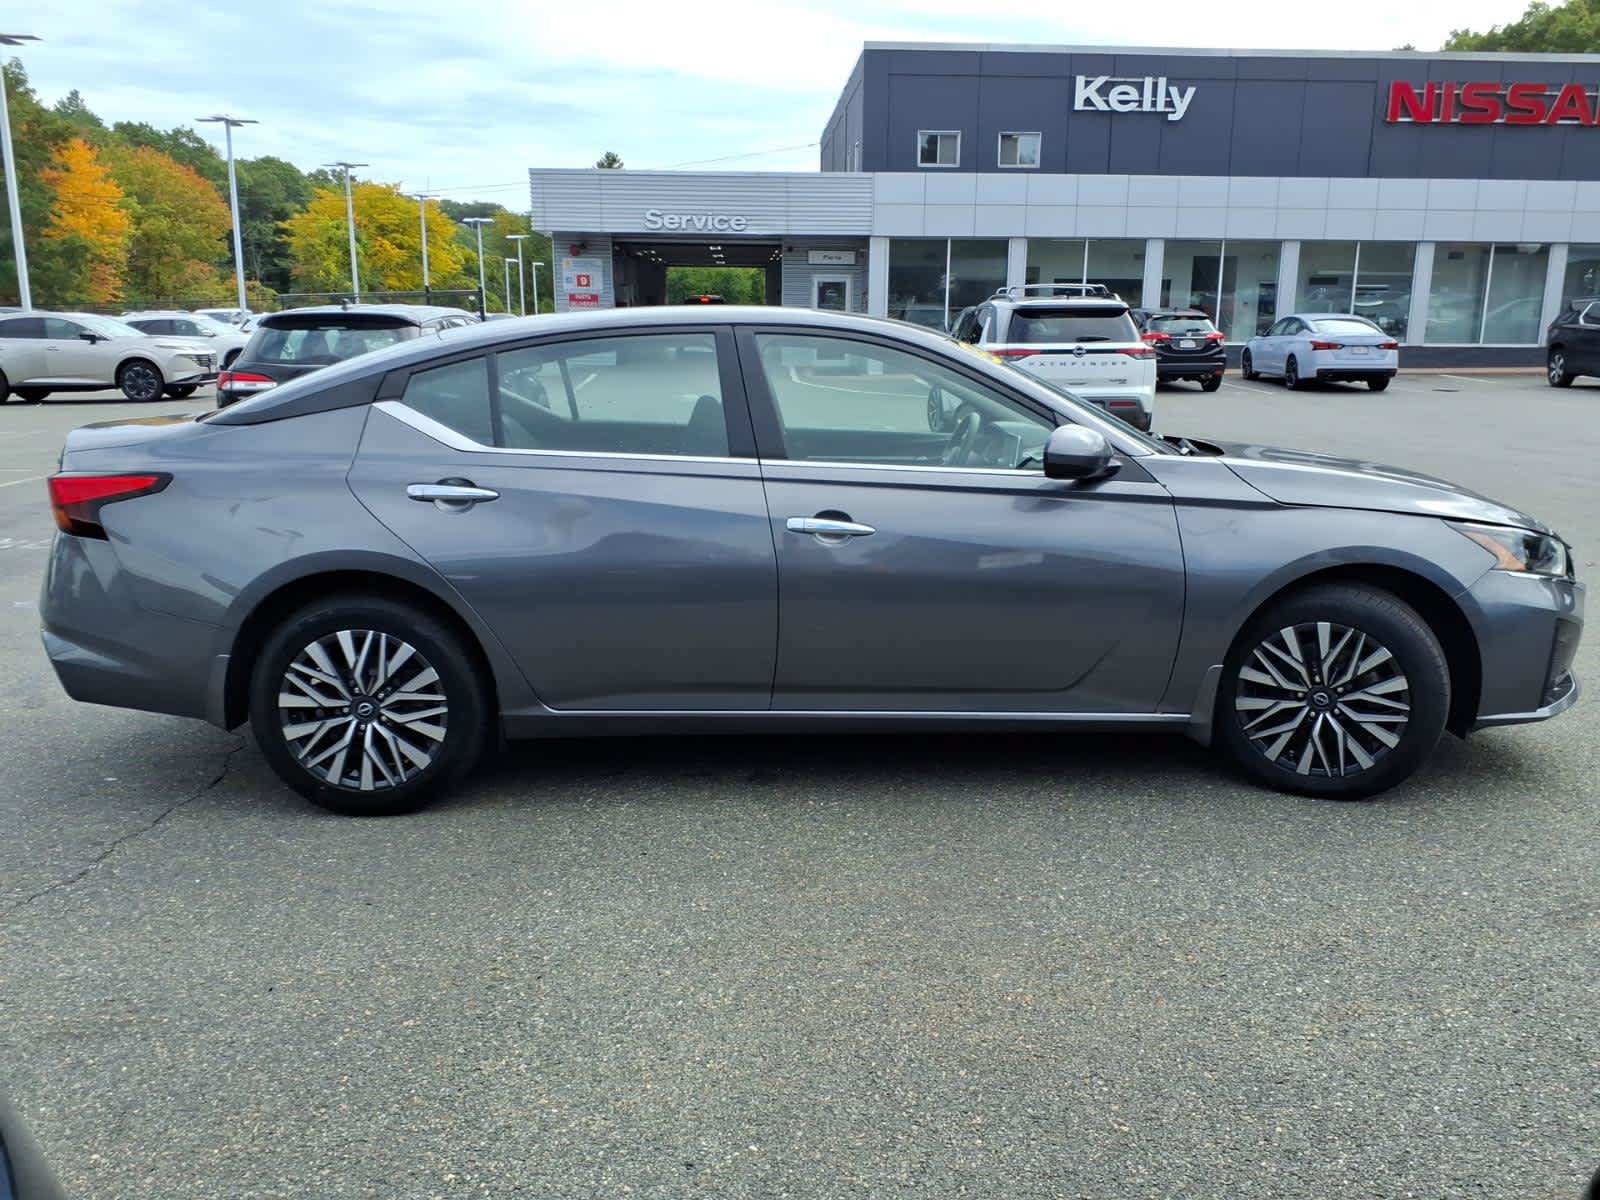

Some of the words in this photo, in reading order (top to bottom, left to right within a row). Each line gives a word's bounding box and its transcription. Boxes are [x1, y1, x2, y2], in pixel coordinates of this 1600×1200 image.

[1074, 75, 1196, 120] Kelly
[1386, 80, 1600, 125] NISSA
[644, 209, 747, 231] Service
